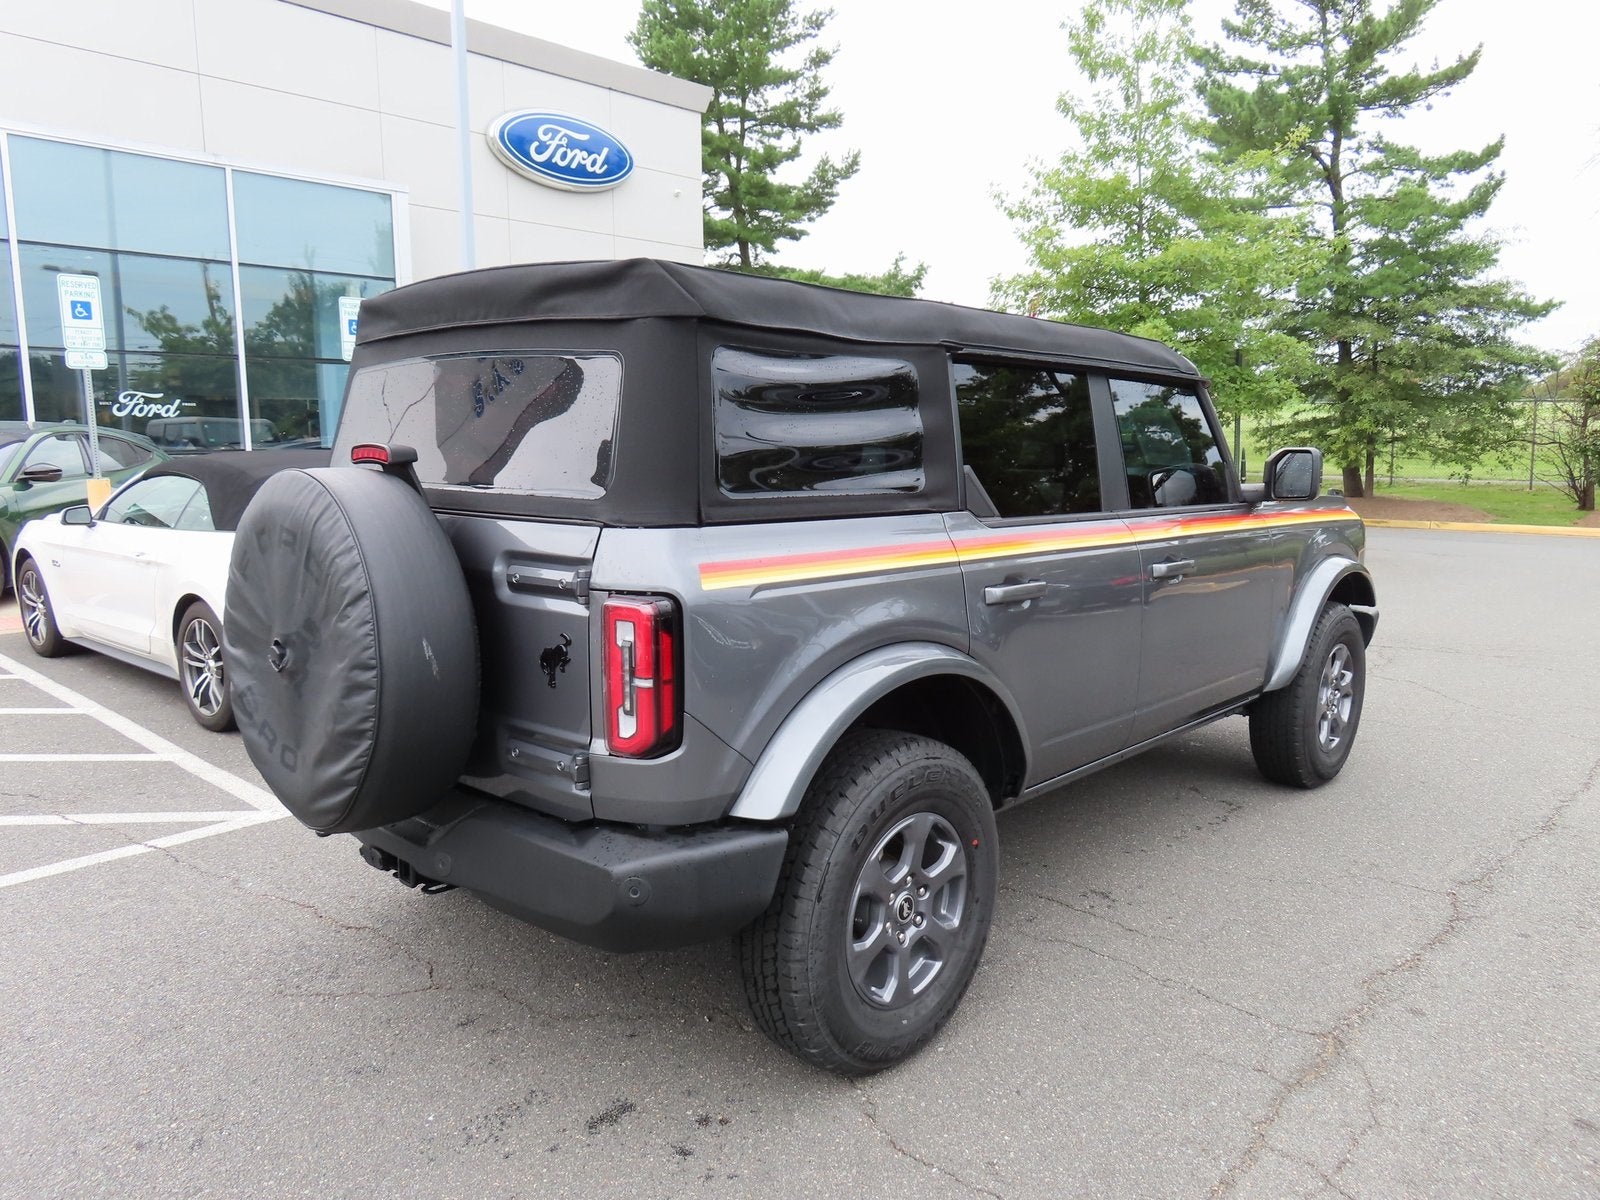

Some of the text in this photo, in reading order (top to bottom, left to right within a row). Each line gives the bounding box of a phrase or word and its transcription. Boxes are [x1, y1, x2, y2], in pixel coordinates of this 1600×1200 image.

[529, 124, 609, 174] Ford
[61, 280, 97, 290] RESERVED
[64, 289, 96, 299] PARKING
[112, 390, 181, 417] Ford
